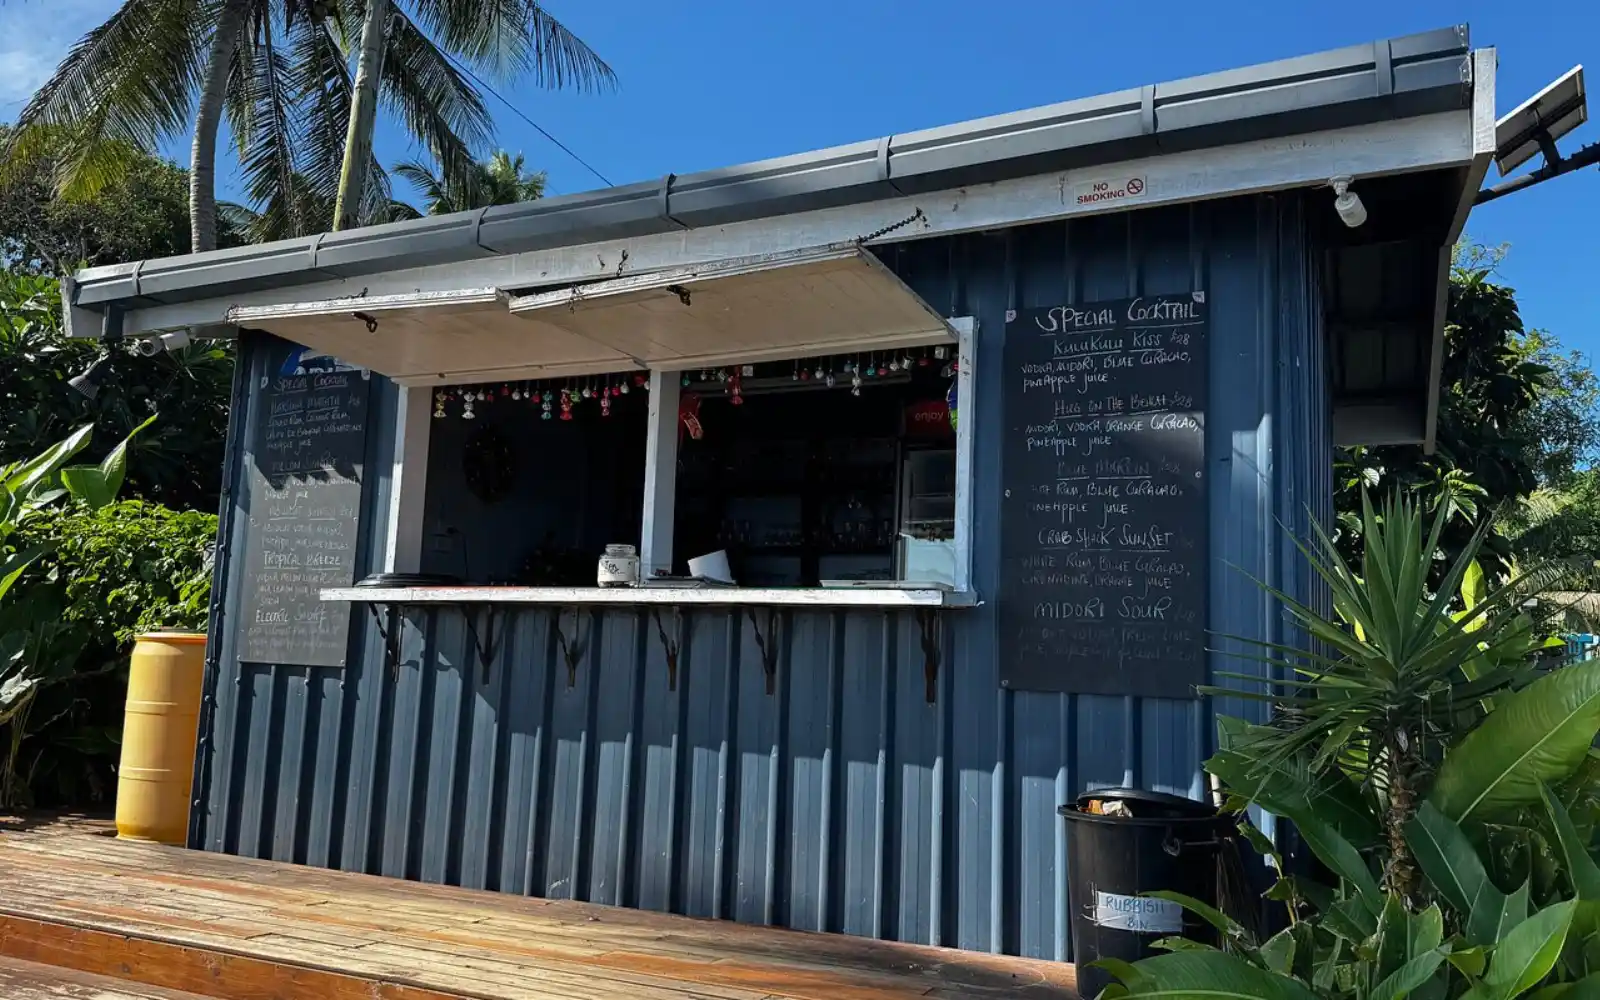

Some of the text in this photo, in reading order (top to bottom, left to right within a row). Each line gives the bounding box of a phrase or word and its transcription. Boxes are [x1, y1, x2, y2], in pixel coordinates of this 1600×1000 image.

[1093, 182, 1108, 192] NO
[1077, 189, 1125, 204] SMOKING
[1035, 297, 1200, 331] SPECIAL COCKTAIL
[1133, 330, 1162, 347] KISS
[1104, 356, 1134, 368] BLUE
[915, 411, 944, 422] enjoy
[1087, 483, 1120, 497] BLUE
[1029, 502, 1088, 523] INEAPPLE
[1119, 524, 1173, 549] SUNSET
[264, 551, 301, 567] TROPICAL
[1034, 598, 1104, 619] MIDORI
[1117, 596, 1172, 620] SOUR
[1127, 917, 1149, 930] BIN
